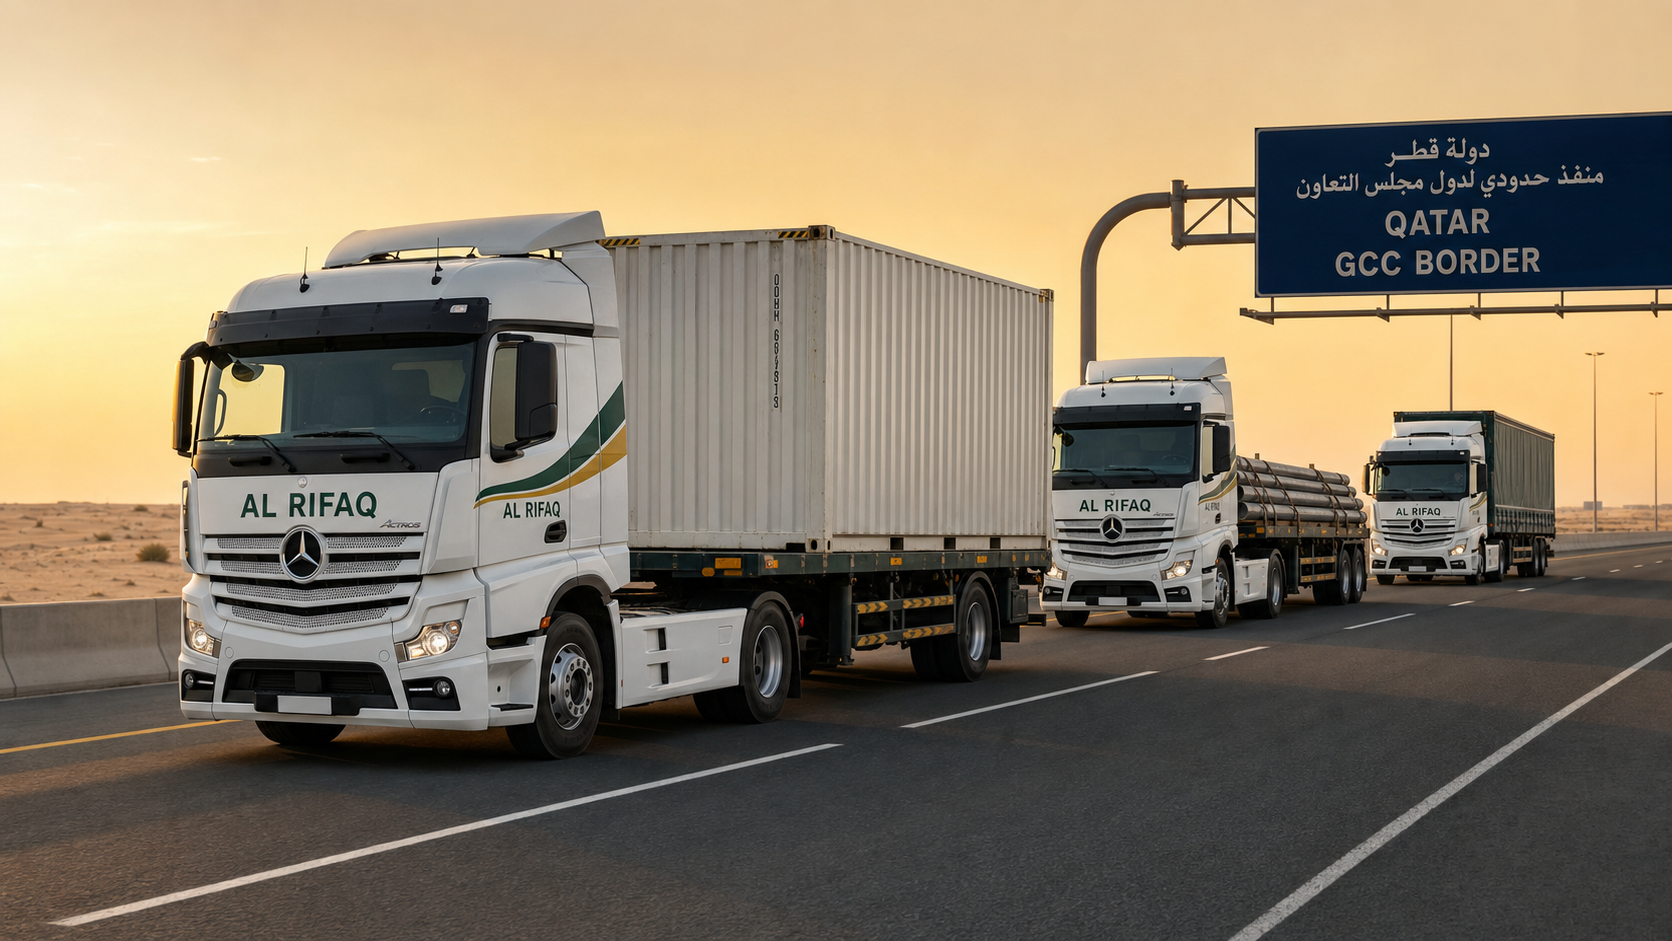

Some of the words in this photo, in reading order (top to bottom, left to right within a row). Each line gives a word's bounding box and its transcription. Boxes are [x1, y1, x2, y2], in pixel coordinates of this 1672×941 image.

[1446, 137, 1490, 165] دولة
[1296, 172, 1359, 200] التعاون
[1365, 171, 1424, 197] مجلس
[1431, 168, 1475, 196] لدول
[1481, 173, 1550, 199] حدودي
[1557, 165, 1604, 185] منفذ
[1385, 209, 1490, 239] QATAR
[1335, 250, 1402, 277] GCC
[1416, 247, 1541, 275] BORDER
[241, 493, 277, 519] AL
[289, 491, 378, 519] RIFAQ
[503, 502, 521, 518] AL
[526, 501, 561, 519] RIFAQ
[1079, 499, 1099, 512] AL
[1105, 498, 1151, 513] RIFAQ
[1396, 507, 1409, 516] AL
[1412, 507, 1441, 517] RIFAQ
